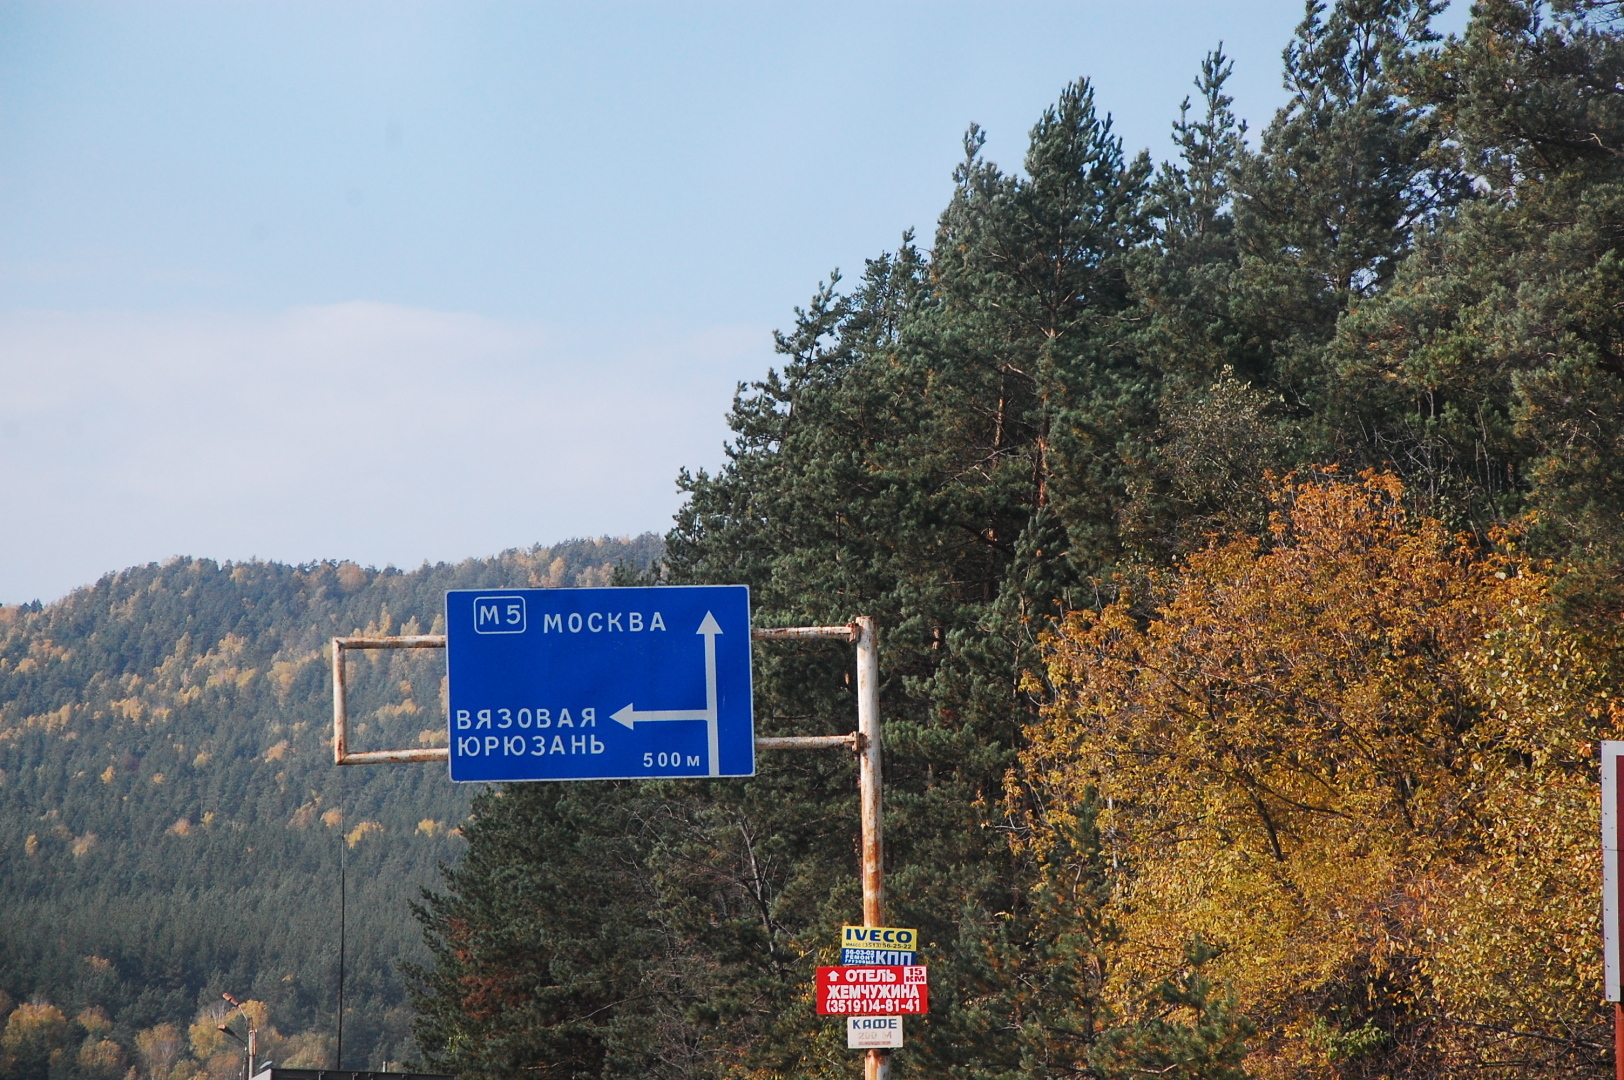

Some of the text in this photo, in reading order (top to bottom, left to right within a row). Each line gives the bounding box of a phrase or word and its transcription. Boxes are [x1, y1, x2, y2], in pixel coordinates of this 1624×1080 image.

[543, 611, 667, 634] МОСКВА
[456, 707, 596, 730] ВЯЗОВАЯ
[457, 734, 605, 757] ЮРЮЗАНЬ
[643, 752, 681, 768] 500
[846, 928, 912, 943] IVECO
[875, 950, 912, 966] КПП
[845, 969, 897, 982] ОТЕЛЬ
[908, 968, 923, 976] 15
[826, 984, 920, 999] ЖЕМЧУЖИНА
[826, 999, 920, 1013] (35191)4-81-41
[852, 1018, 897, 1029] КАФЕ
